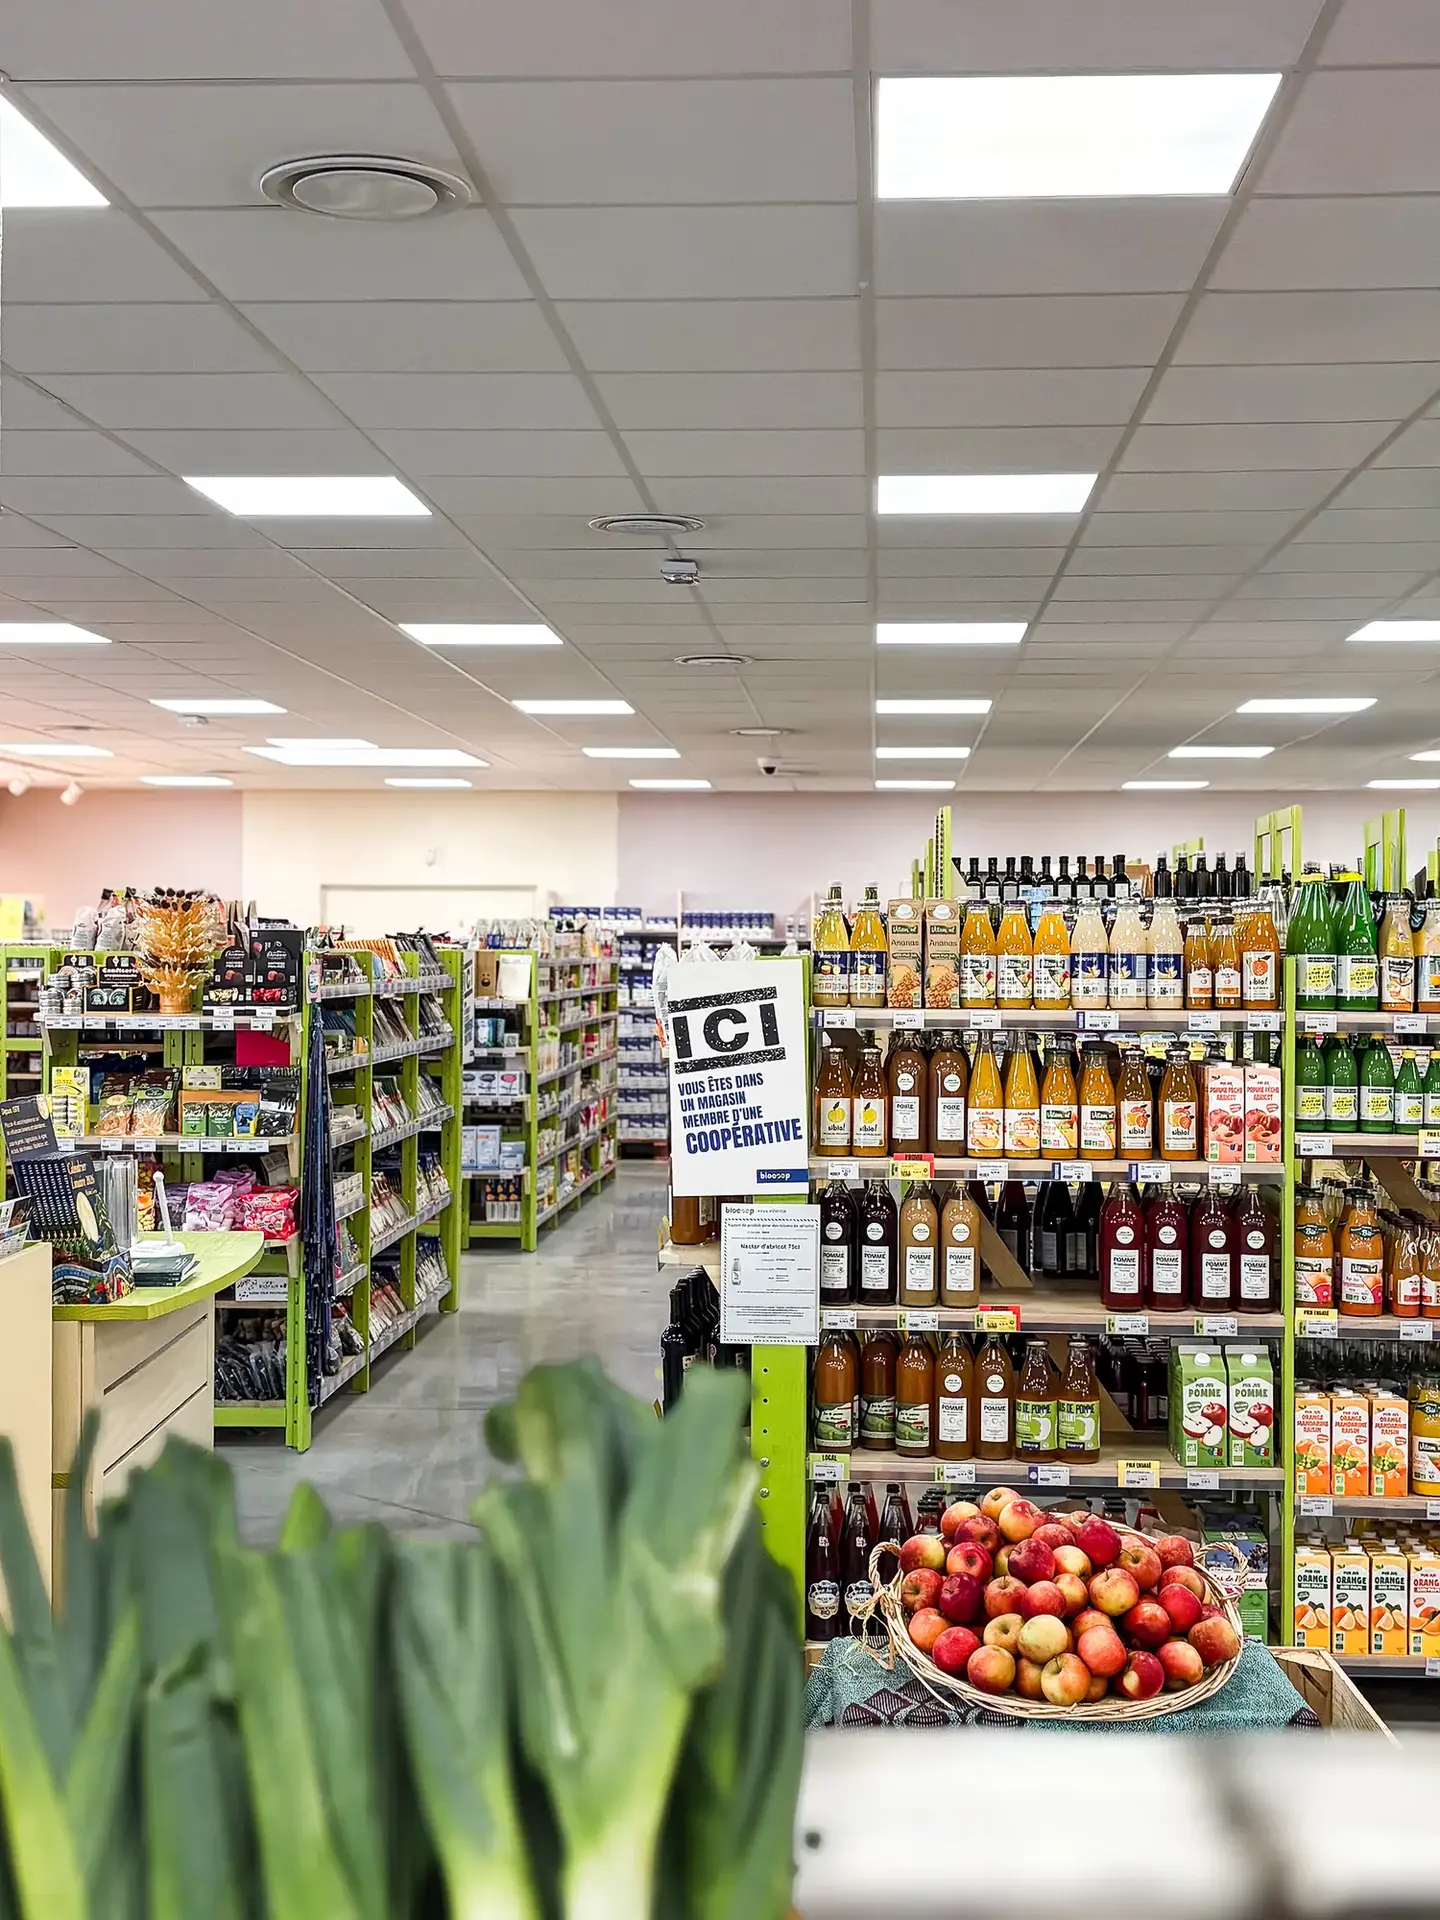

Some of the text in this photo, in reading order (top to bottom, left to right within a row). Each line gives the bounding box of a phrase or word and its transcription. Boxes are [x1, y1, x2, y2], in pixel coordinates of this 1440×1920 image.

[891, 938, 920, 947] Ananas
[929, 938, 957, 947] Ananas
[672, 1003, 780, 1060] ICI
[678, 1073, 764, 1096] VOUS ÊTES DANS
[680, 1091, 747, 1112] UN MAGASIN
[682, 1106, 763, 1129] MEMBRE D'UNE
[685, 1118, 803, 1154] COOPÉRATIVE
[1189, 1388, 1221, 1397] POMME
[1235, 1388, 1268, 1397] POMME
[1023, 1403, 1030, 1413] DE
[1031, 1403, 1051, 1414] POMME
[1067, 1403, 1074, 1413] DE
[1076, 1403, 1095, 1414] POMME
[822, 1454, 837, 1462] LOCAL
[1297, 1574, 1328, 1583] ORANGE
[1336, 1575, 1366, 1584] ORANGE
[1374, 1575, 1405, 1584] ORANGE
[1413, 1578, 1440, 1587] ORANG
